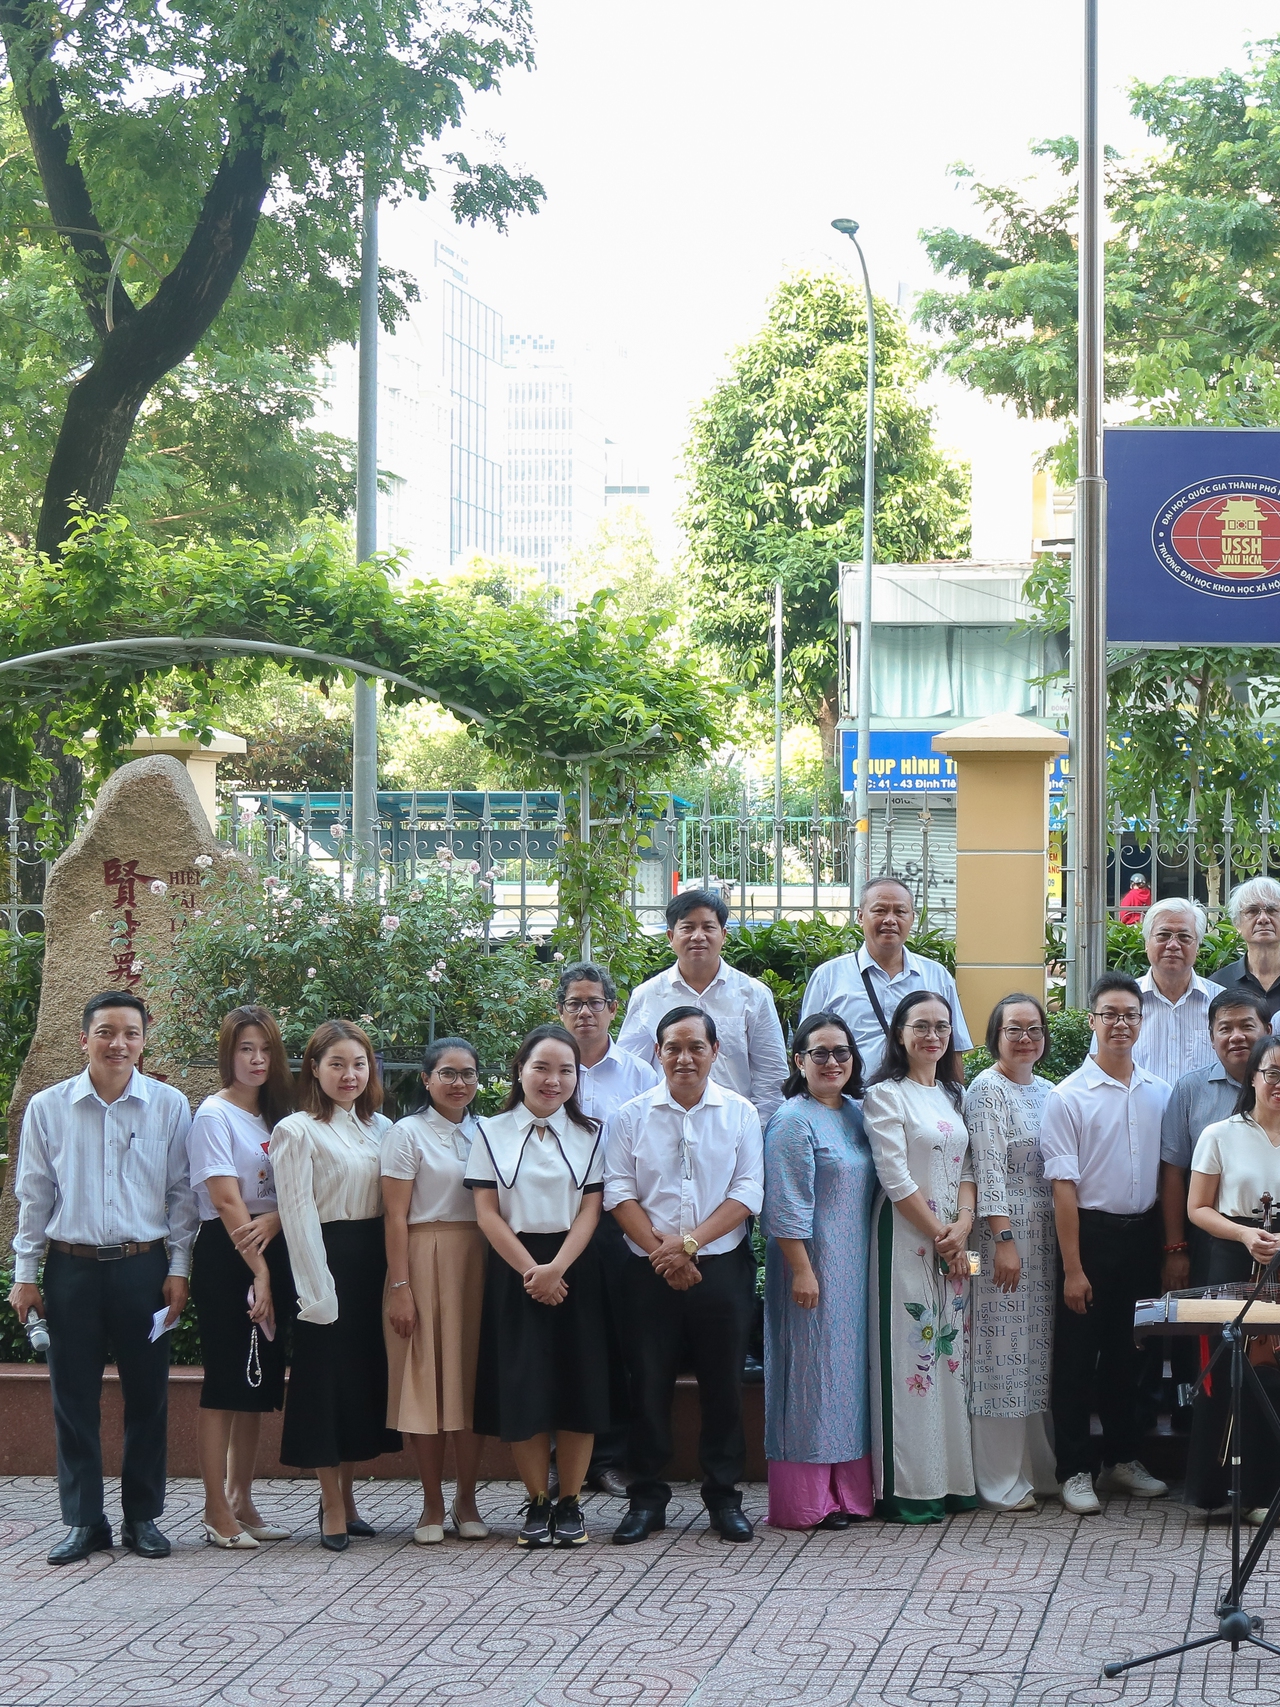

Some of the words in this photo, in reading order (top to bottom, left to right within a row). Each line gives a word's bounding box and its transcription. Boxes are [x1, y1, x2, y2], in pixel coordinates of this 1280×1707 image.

[1171, 496, 1188, 512] HỌC
[1188, 486, 1211, 500] QUỐC
[1212, 483, 1227, 492] GIA
[1228, 481, 1257, 490] THÀNH
[1221, 538, 1262, 554] USSH
[1222, 555, 1240, 565] VNU
[1242, 555, 1262, 565] HCM
[1194, 577, 1212, 589] HỌC
[1212, 583, 1236, 594] KHOA
[1237, 586, 1255, 595] HỌC
[900, 756, 940, 775] HÌNH
[878, 779, 890, 788] 41
[900, 779, 913, 788] 43
[940, 779, 957, 788] Tiê
[988, 1300, 1026, 1313] USSH
[992, 1396, 1027, 1409] USSH
